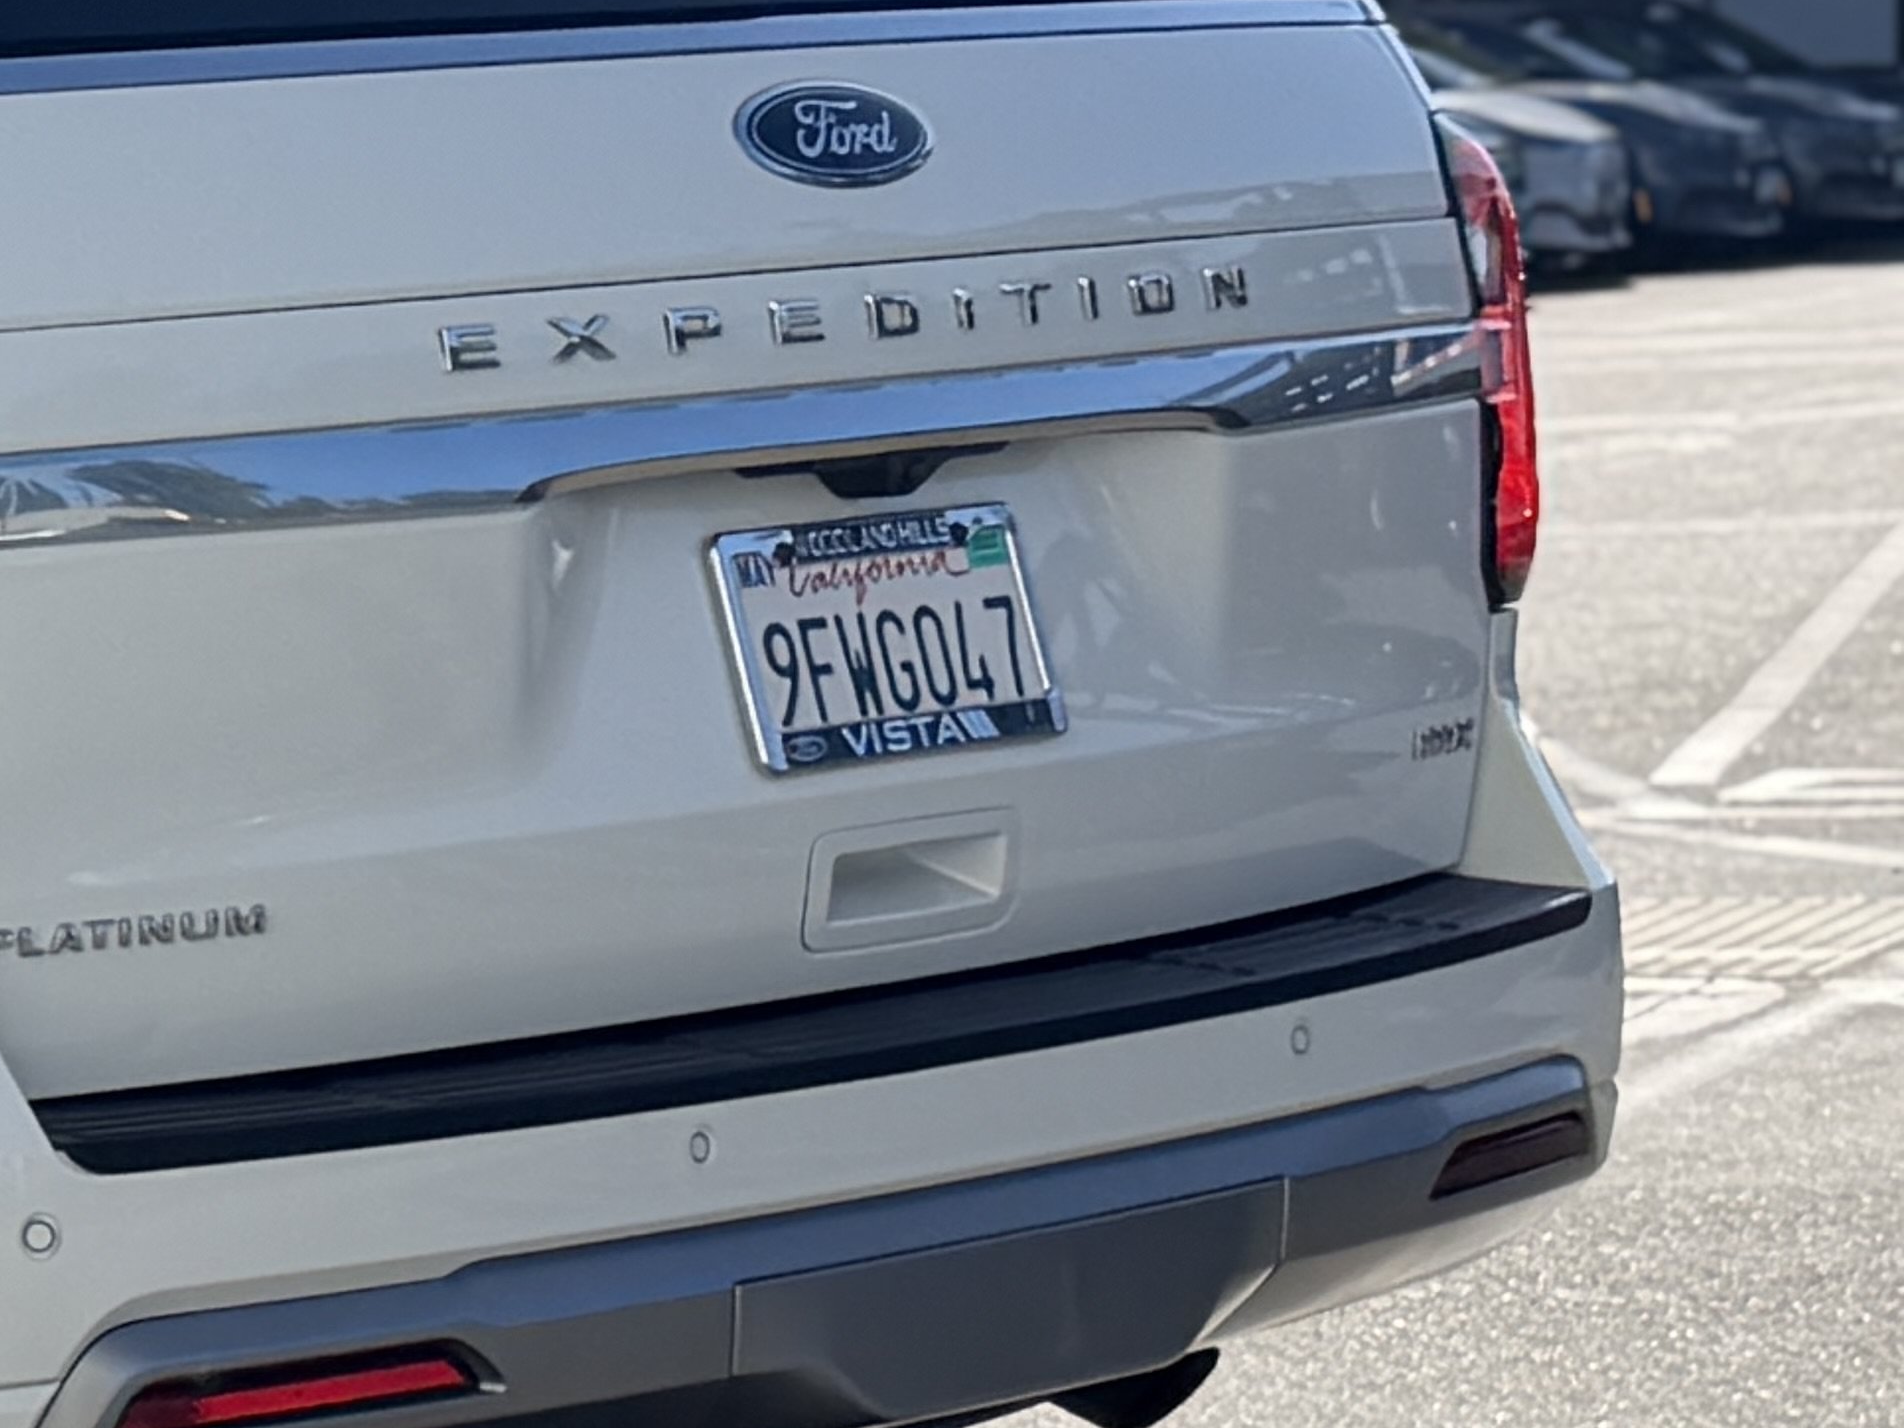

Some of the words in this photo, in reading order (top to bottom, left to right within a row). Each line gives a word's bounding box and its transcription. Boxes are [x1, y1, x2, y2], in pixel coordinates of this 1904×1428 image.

[793, 99, 898, 158] Ford
[437, 264, 1252, 373] EXPEDITION
[762, 595, 1024, 728] 9FWG047
[841, 712, 966, 758] VISTA
